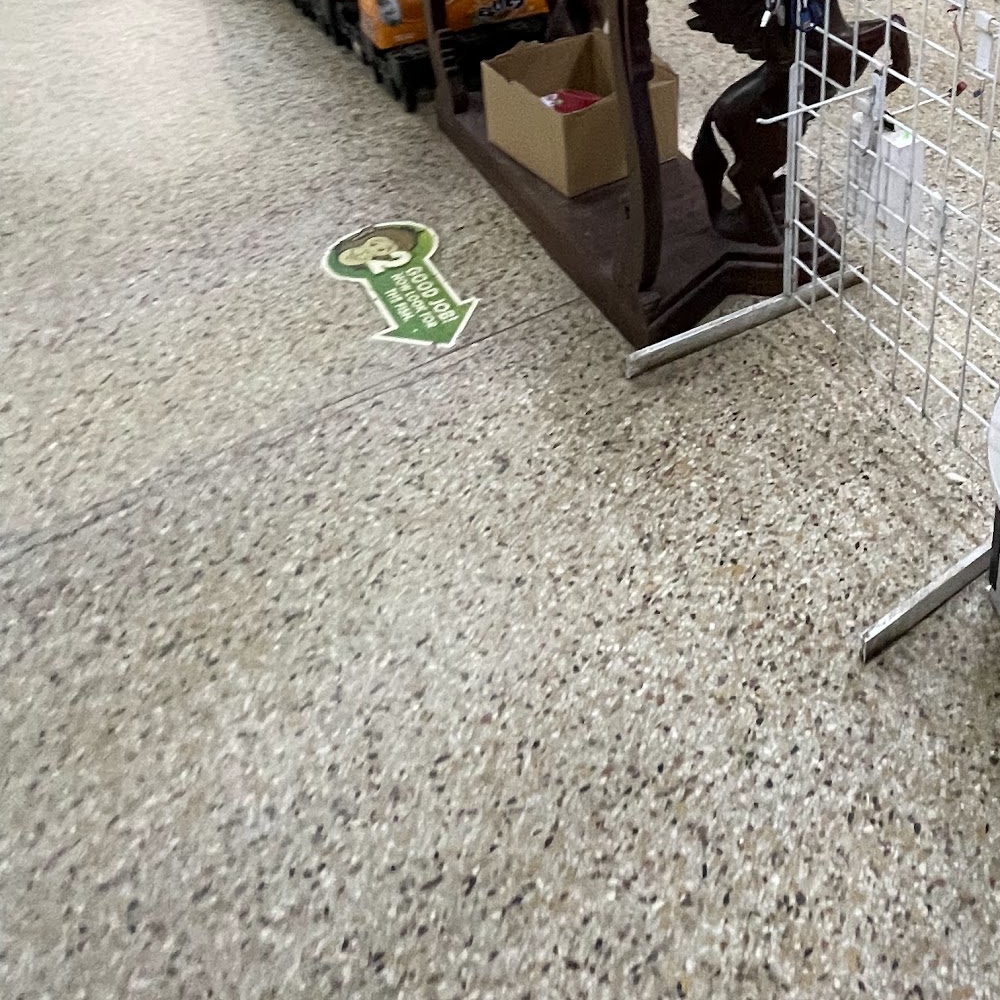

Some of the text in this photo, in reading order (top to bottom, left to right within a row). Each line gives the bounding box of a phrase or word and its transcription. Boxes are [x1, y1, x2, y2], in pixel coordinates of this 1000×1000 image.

[391, 272, 439, 329] NOW LOOK FOR
[405, 266, 460, 324] GOOD JOB!
